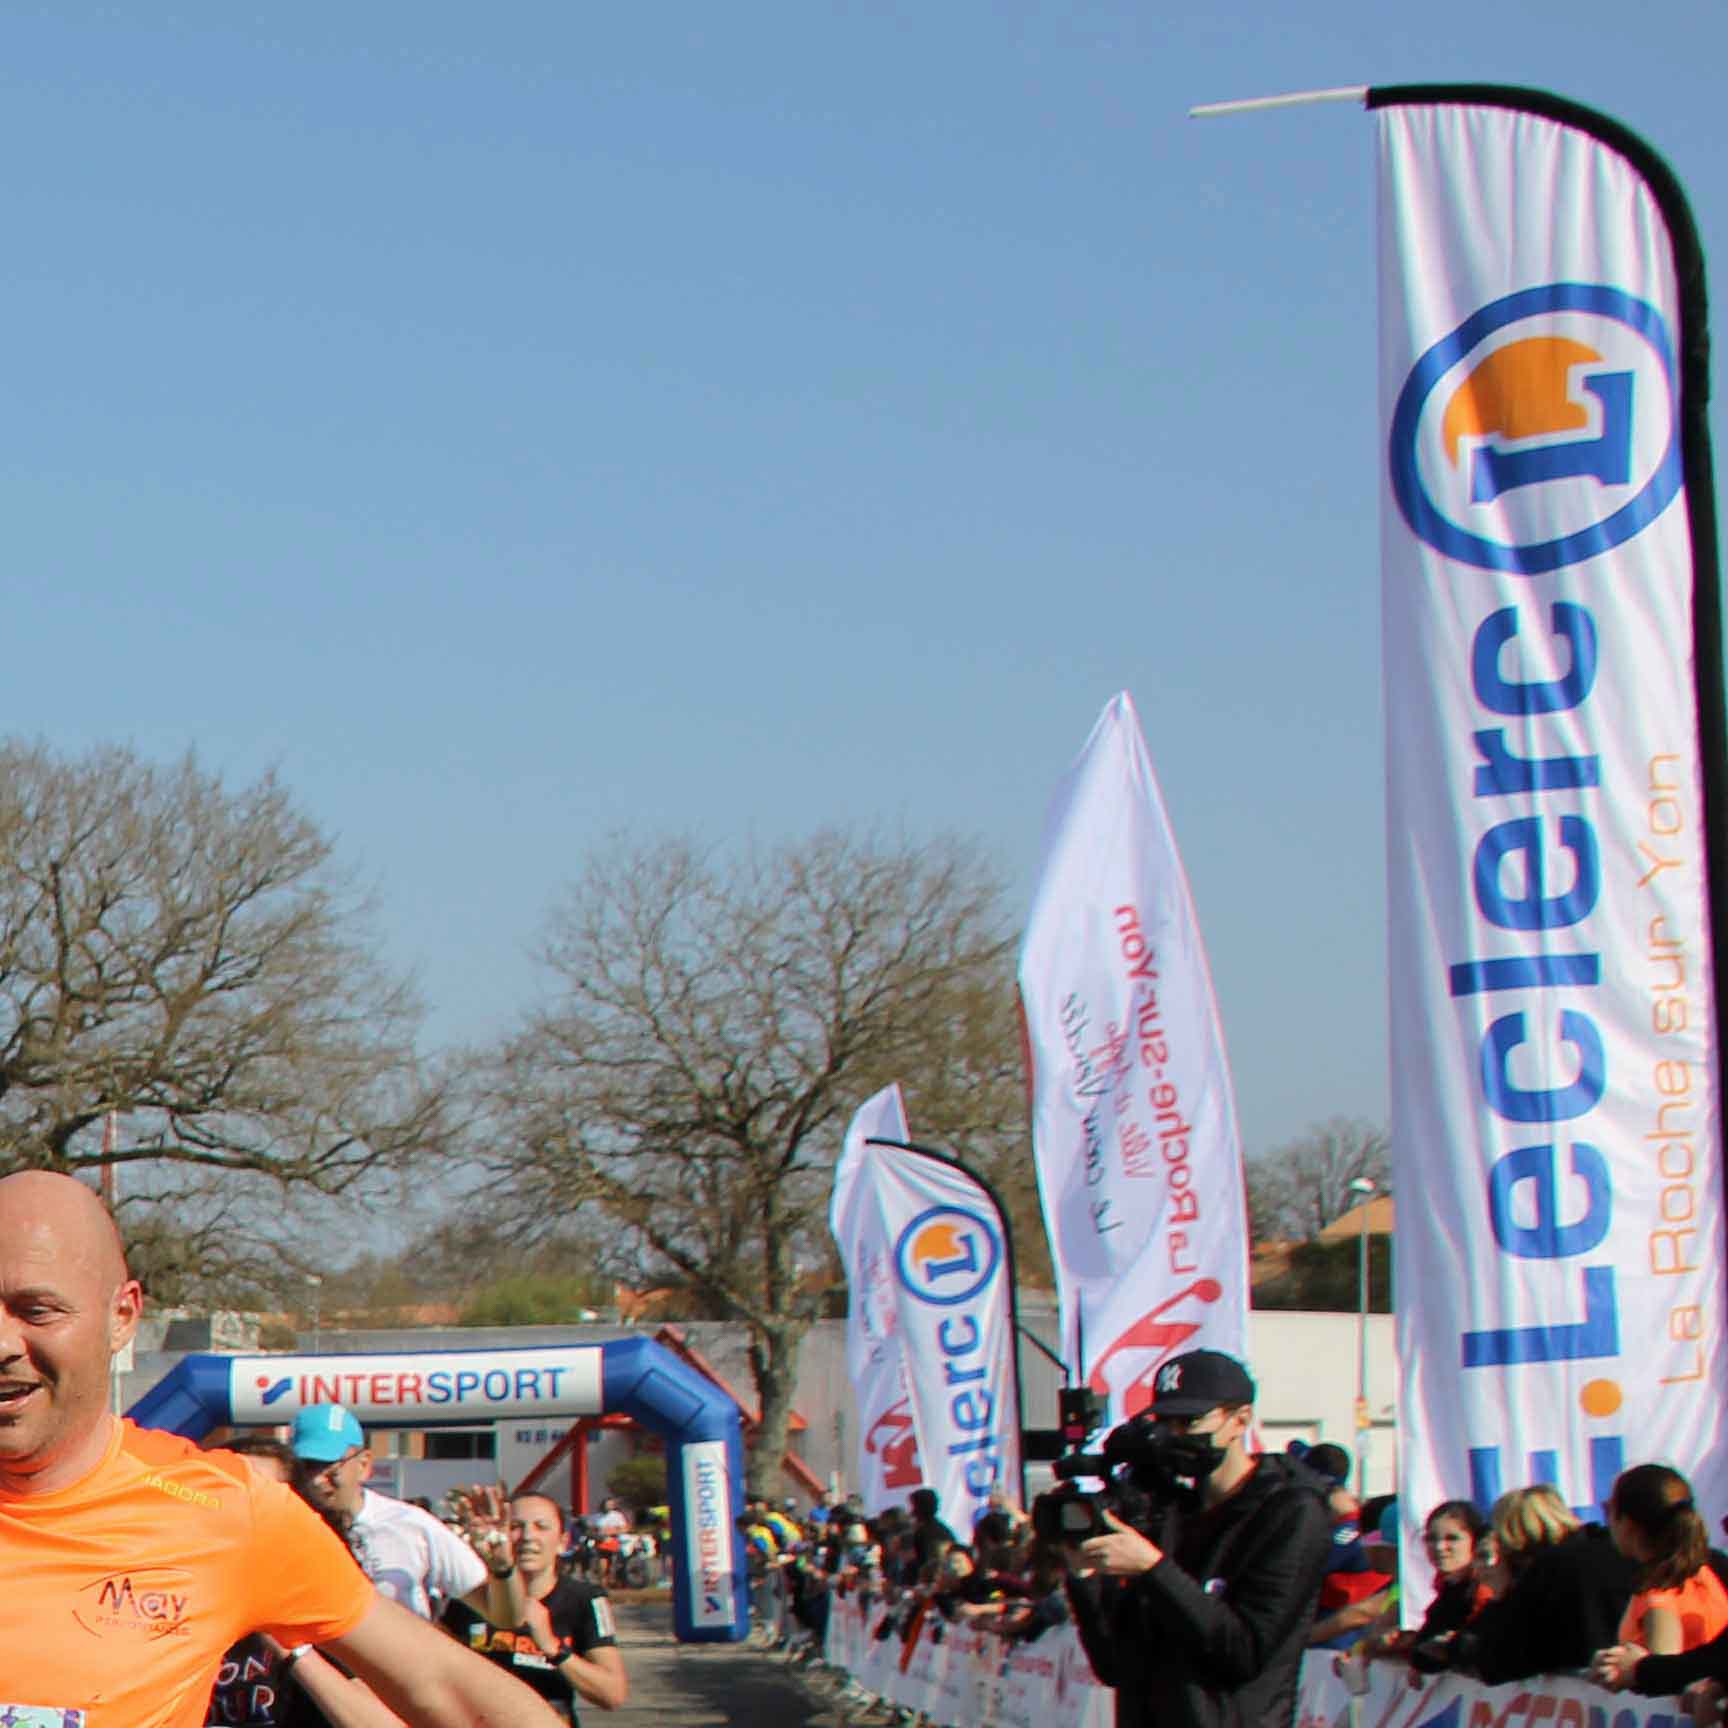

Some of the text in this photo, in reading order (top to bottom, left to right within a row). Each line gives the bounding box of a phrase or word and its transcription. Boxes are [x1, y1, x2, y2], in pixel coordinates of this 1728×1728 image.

[1637, 751, 1706, 1387] La Roche sur Yon
[298, 1366, 567, 1407] INTERSPORT
[695, 1458, 719, 1593] INTERSPORT
